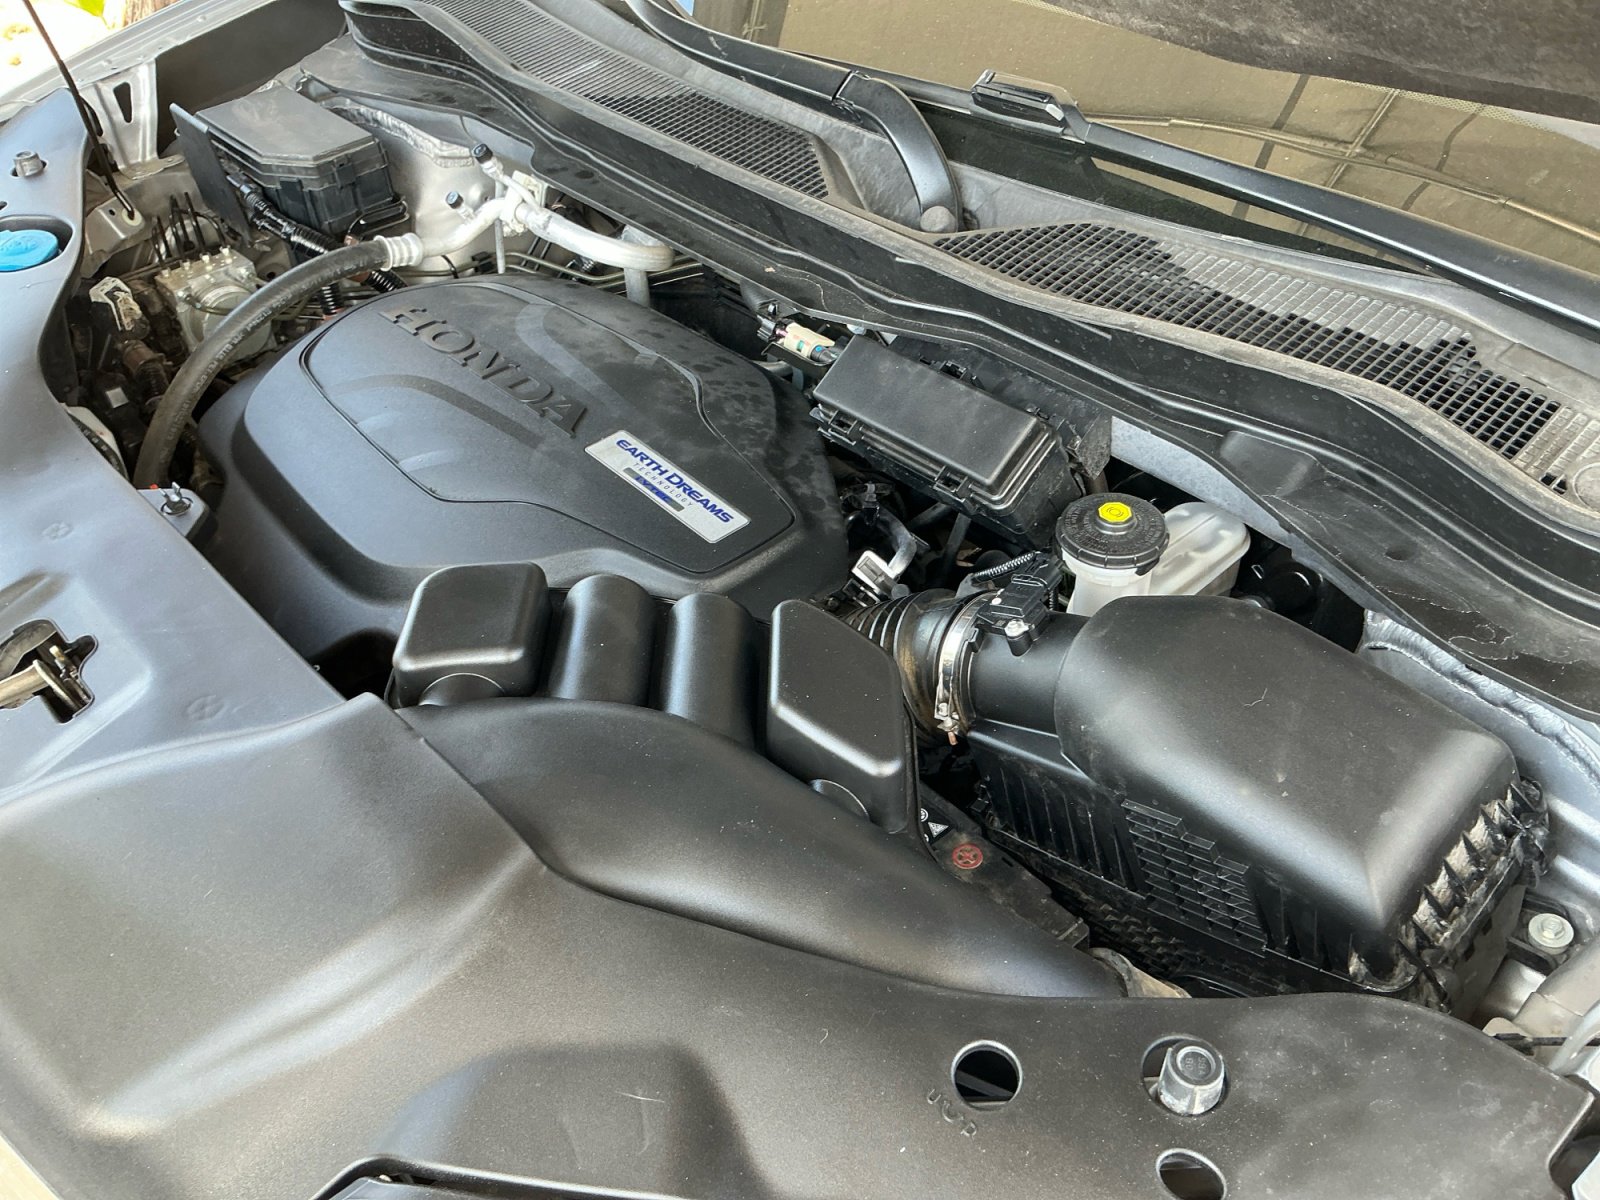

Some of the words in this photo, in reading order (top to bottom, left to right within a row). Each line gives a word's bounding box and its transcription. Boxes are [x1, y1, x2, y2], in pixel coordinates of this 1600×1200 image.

[379, 304, 588, 440] HONDA
[616, 439, 668, 476] EARTH
[665, 472, 734, 523] DREAMS
[633, 462, 693, 507] TECHNOLOGY
